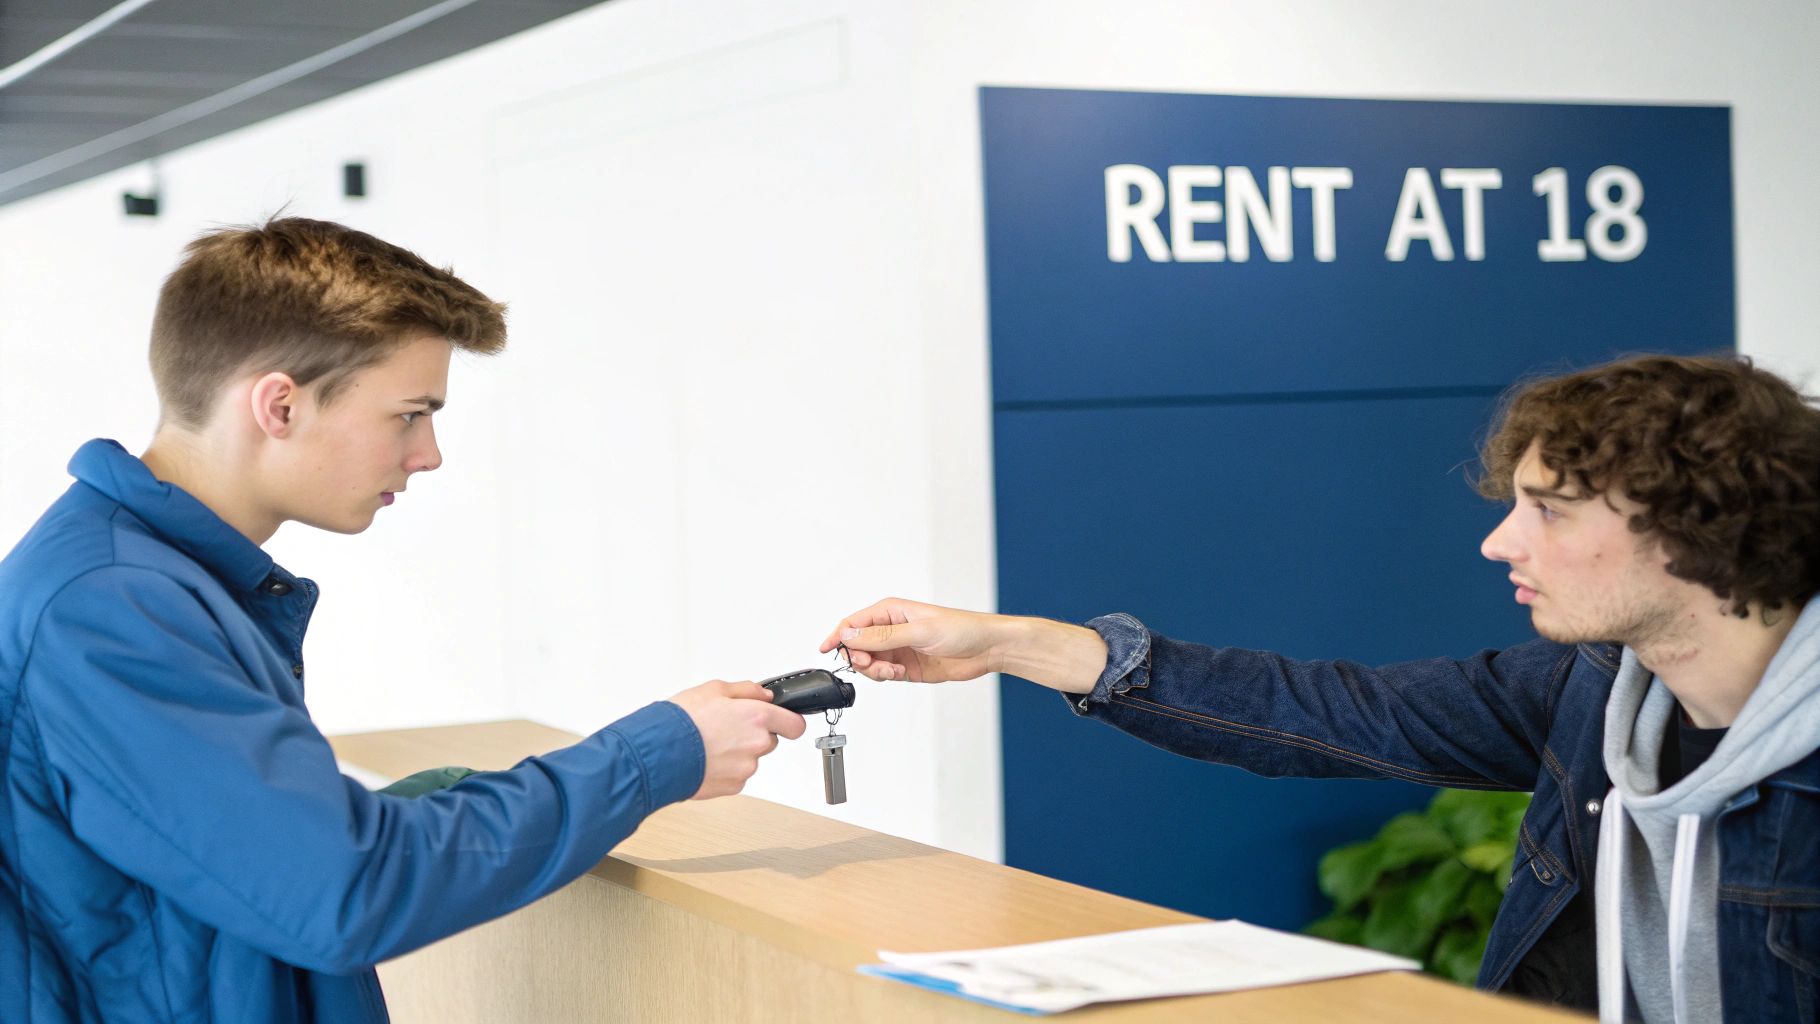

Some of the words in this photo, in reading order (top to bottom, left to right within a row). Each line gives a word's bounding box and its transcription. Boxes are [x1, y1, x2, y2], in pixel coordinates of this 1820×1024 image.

[1104, 163, 1353, 263] RENT
[1386, 167, 1502, 262] AT
[1533, 166, 1648, 262] 18
